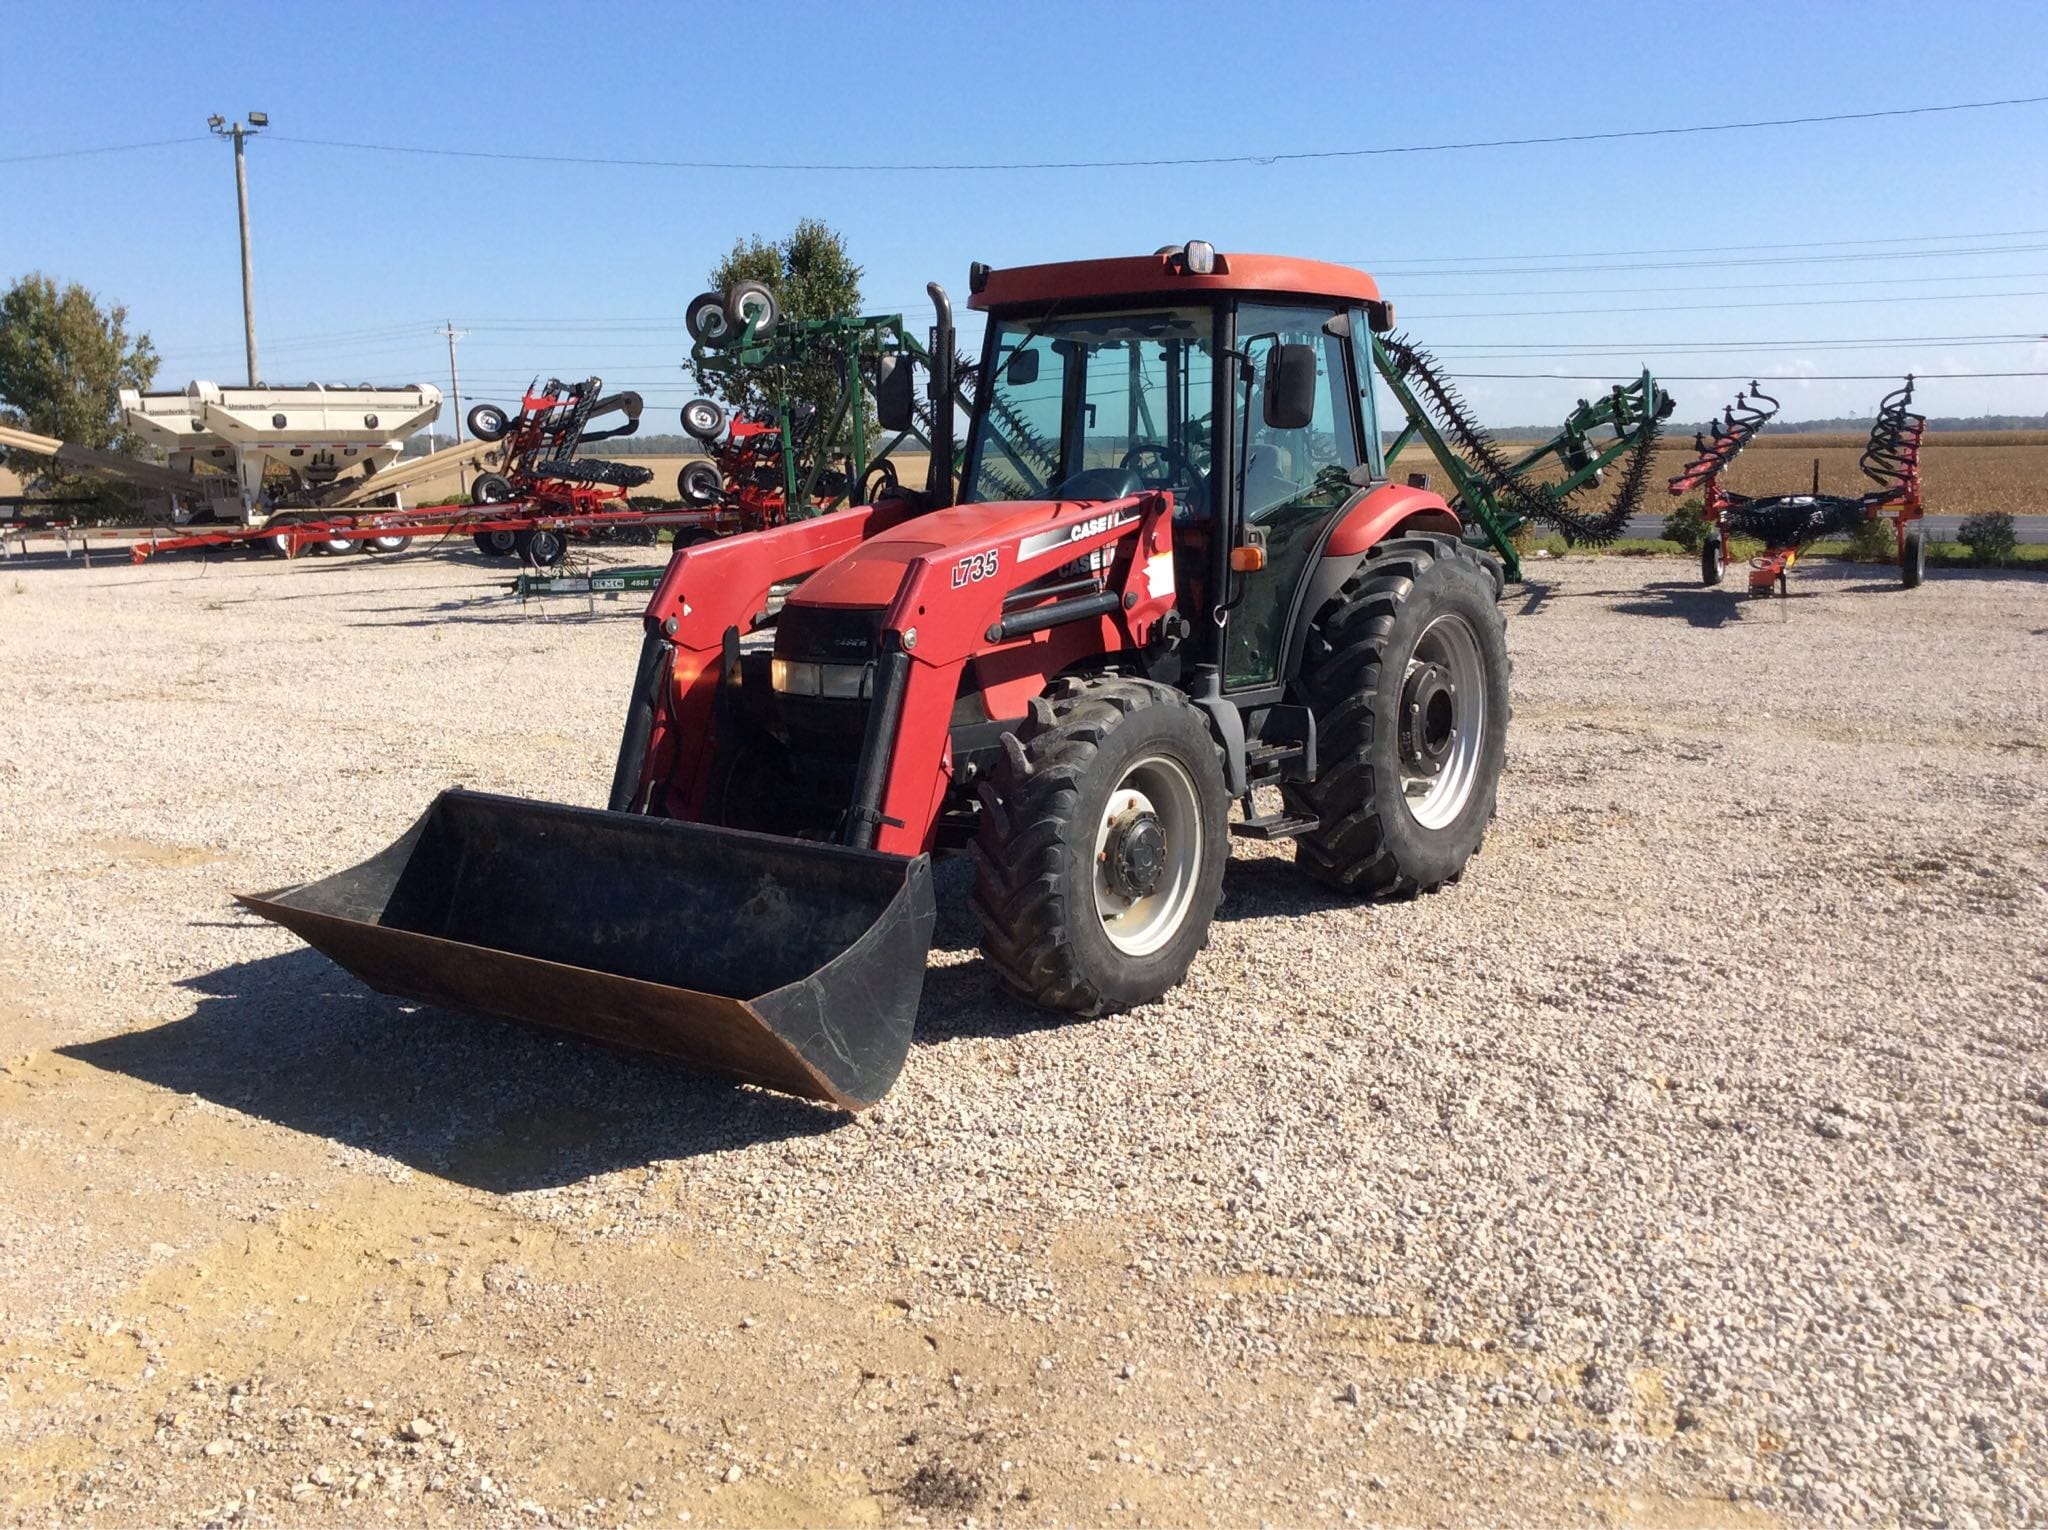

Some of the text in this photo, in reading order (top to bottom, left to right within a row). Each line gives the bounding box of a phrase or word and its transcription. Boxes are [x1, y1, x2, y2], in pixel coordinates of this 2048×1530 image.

[1071, 516, 1107, 541] CASE
[952, 550, 998, 589] L735
[1058, 550, 1101, 577] CASE
